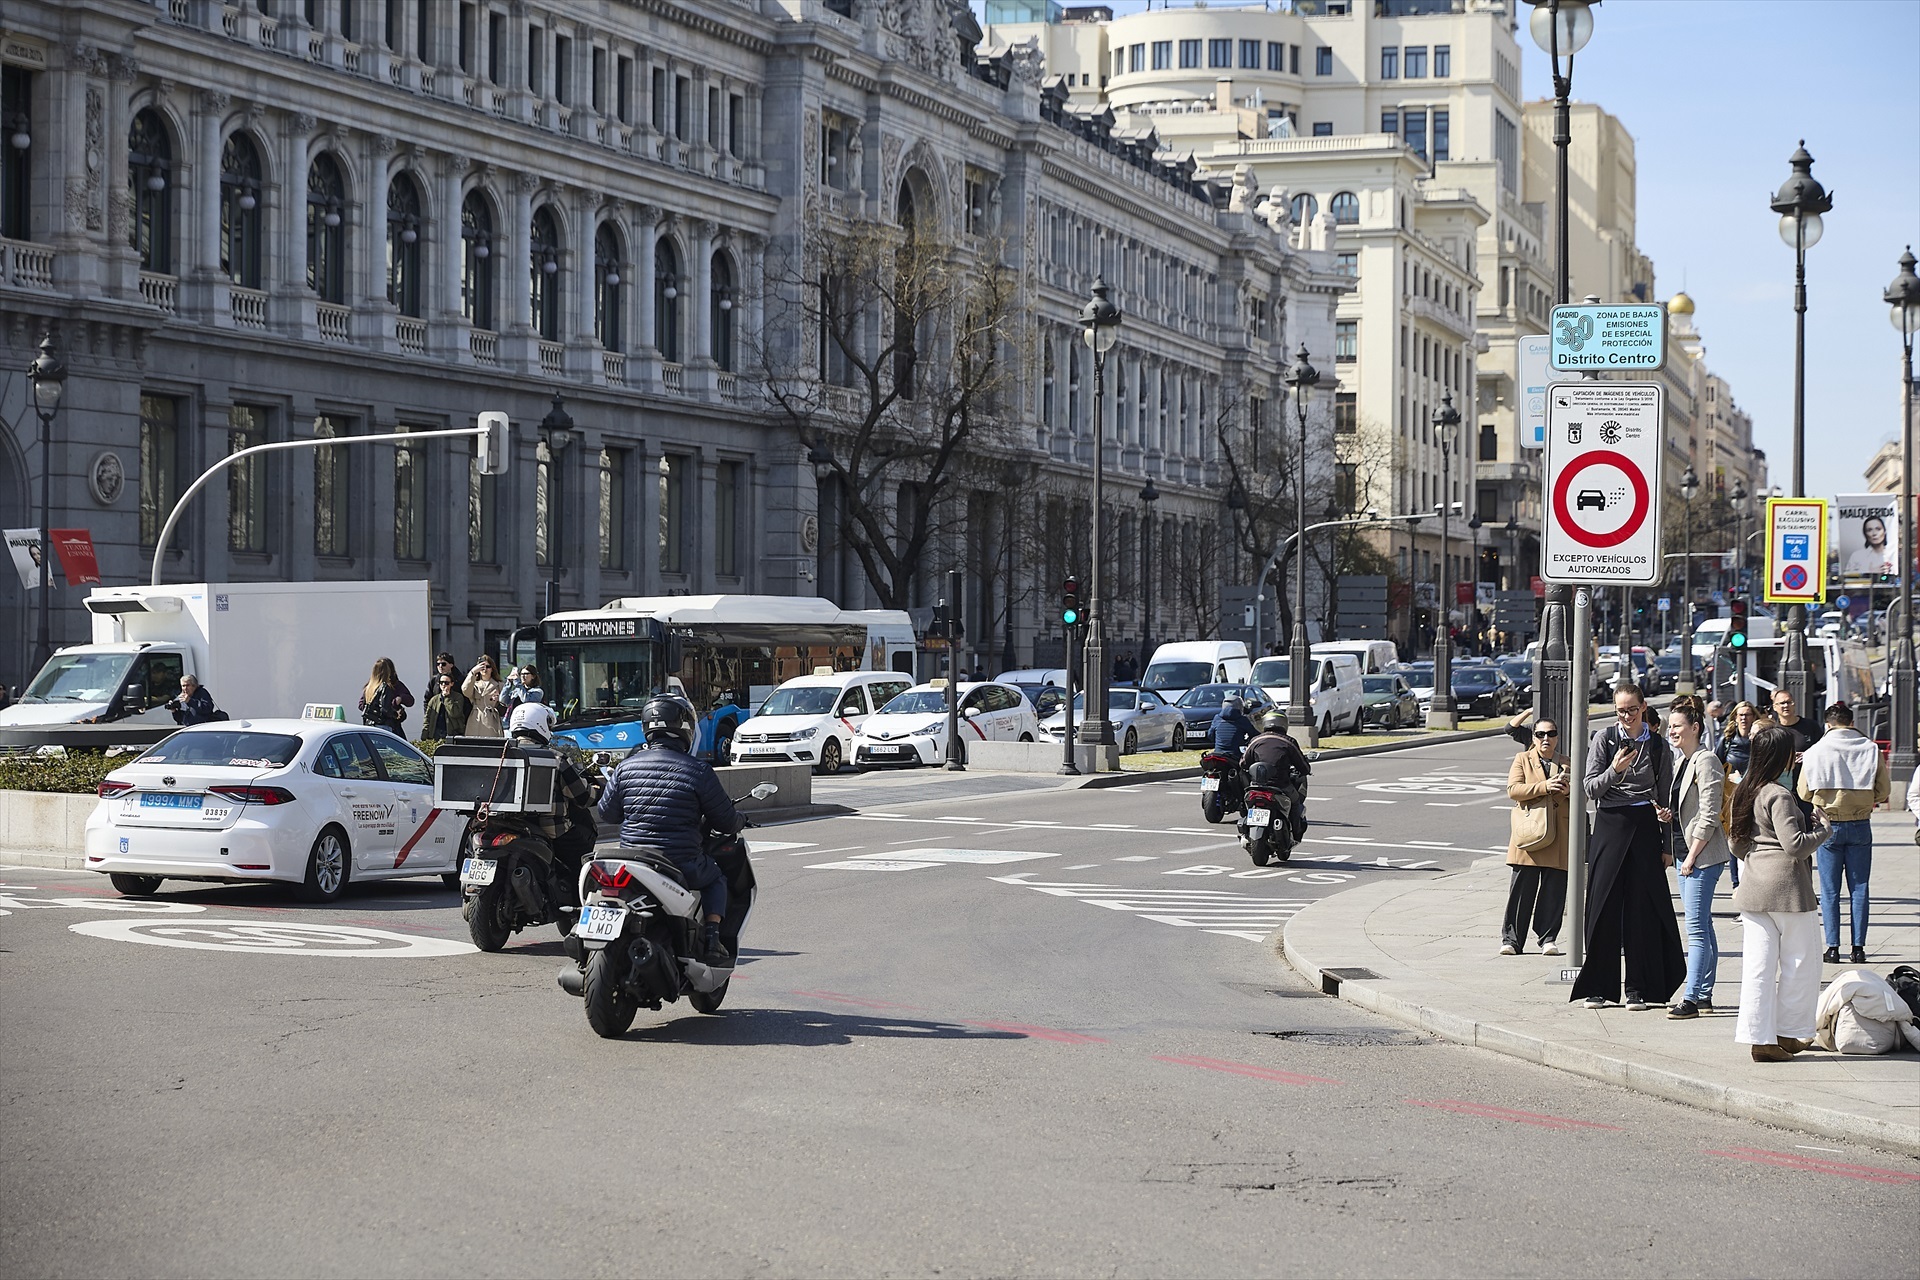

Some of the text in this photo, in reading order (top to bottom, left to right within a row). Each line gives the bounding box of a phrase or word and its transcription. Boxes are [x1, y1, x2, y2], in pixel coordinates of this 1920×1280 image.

[1556, 311, 1579, 319] MADRID
[1602, 339, 1652, 347] PROTECCIÓN
[1558, 353, 1656, 364] Distrito Centro
[1839, 507, 1895, 520] MALQUERIDA
[1553, 553, 1647, 564] EXCEPTO VEHÍCULOS
[1567, 565, 1631, 574] AUTORIZADOS
[561, 620, 635, 638] 20 PAVONES
[315, 707, 334, 718] TAXI
[147, 795, 201, 808] 9994 MMS
[352, 810, 386, 820] FREENOW
[470, 860, 496, 871] 9857
[1160, 865, 1357, 885] BUS
[591, 908, 623, 923] 0337
[587, 921, 614, 935] LMD
[150, 925, 381, 947] 30
